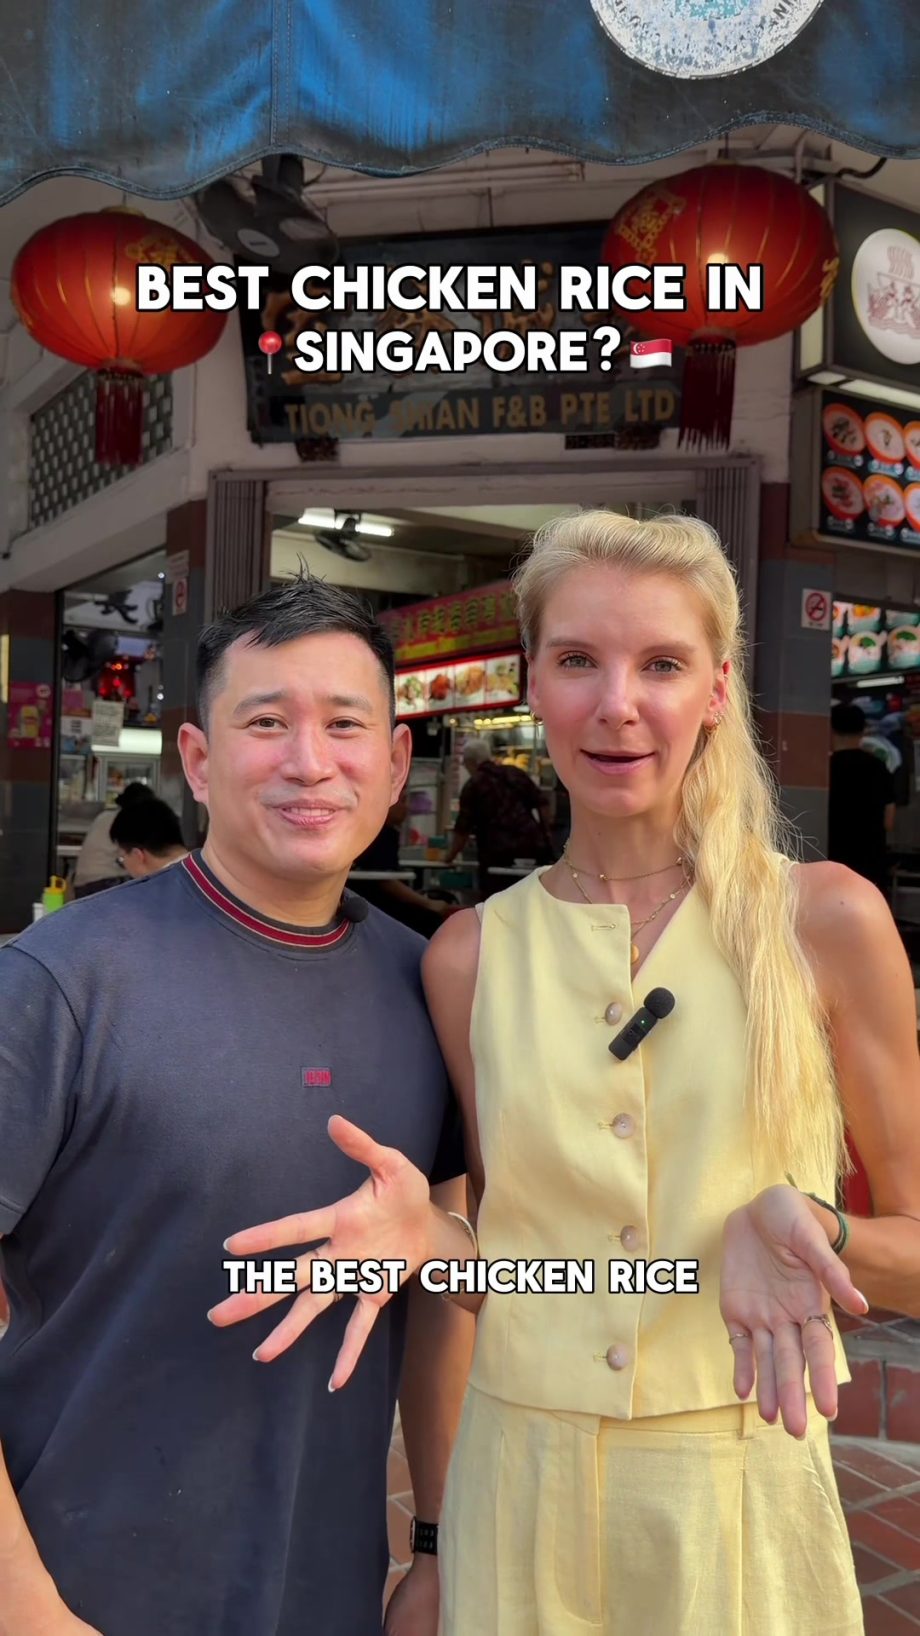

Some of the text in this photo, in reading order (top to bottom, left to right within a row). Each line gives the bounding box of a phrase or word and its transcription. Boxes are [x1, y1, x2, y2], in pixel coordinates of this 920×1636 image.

[285, 389, 675, 435] TIONG SHIAN F&B PTE LTD
